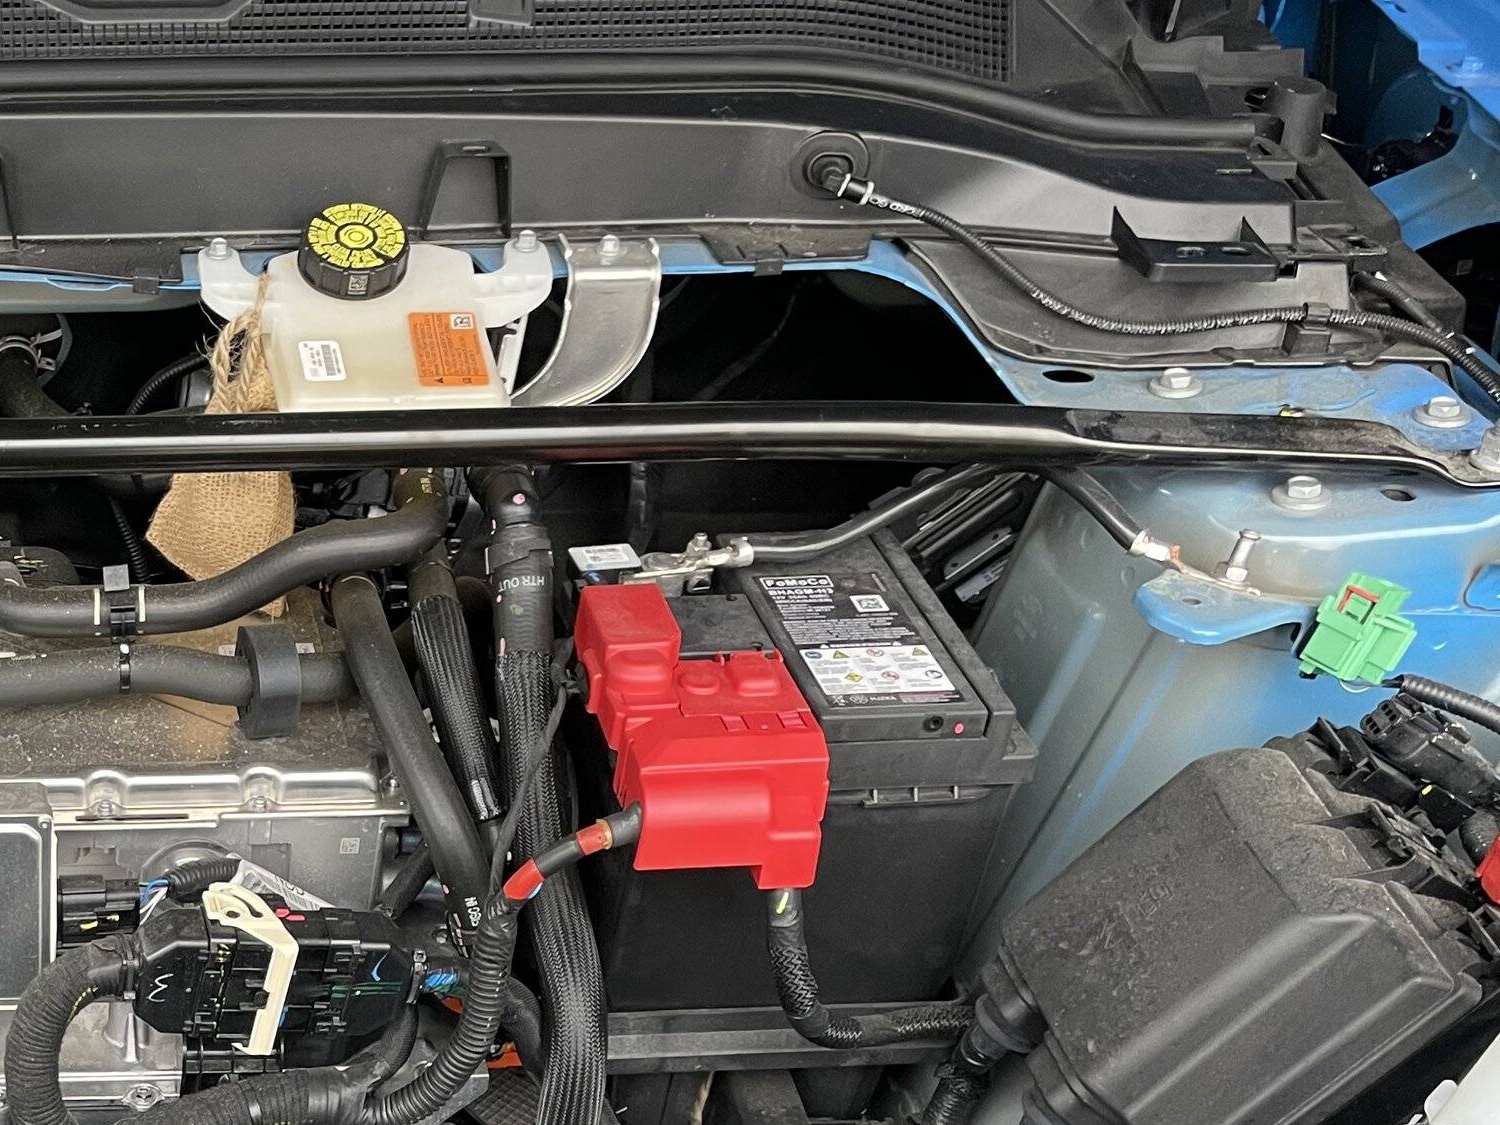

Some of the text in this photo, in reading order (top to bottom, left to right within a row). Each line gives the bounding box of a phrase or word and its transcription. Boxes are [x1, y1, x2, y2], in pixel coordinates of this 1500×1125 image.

[498, 575, 545, 593] HTR OUT
[764, 578, 831, 587] FoMoCo
